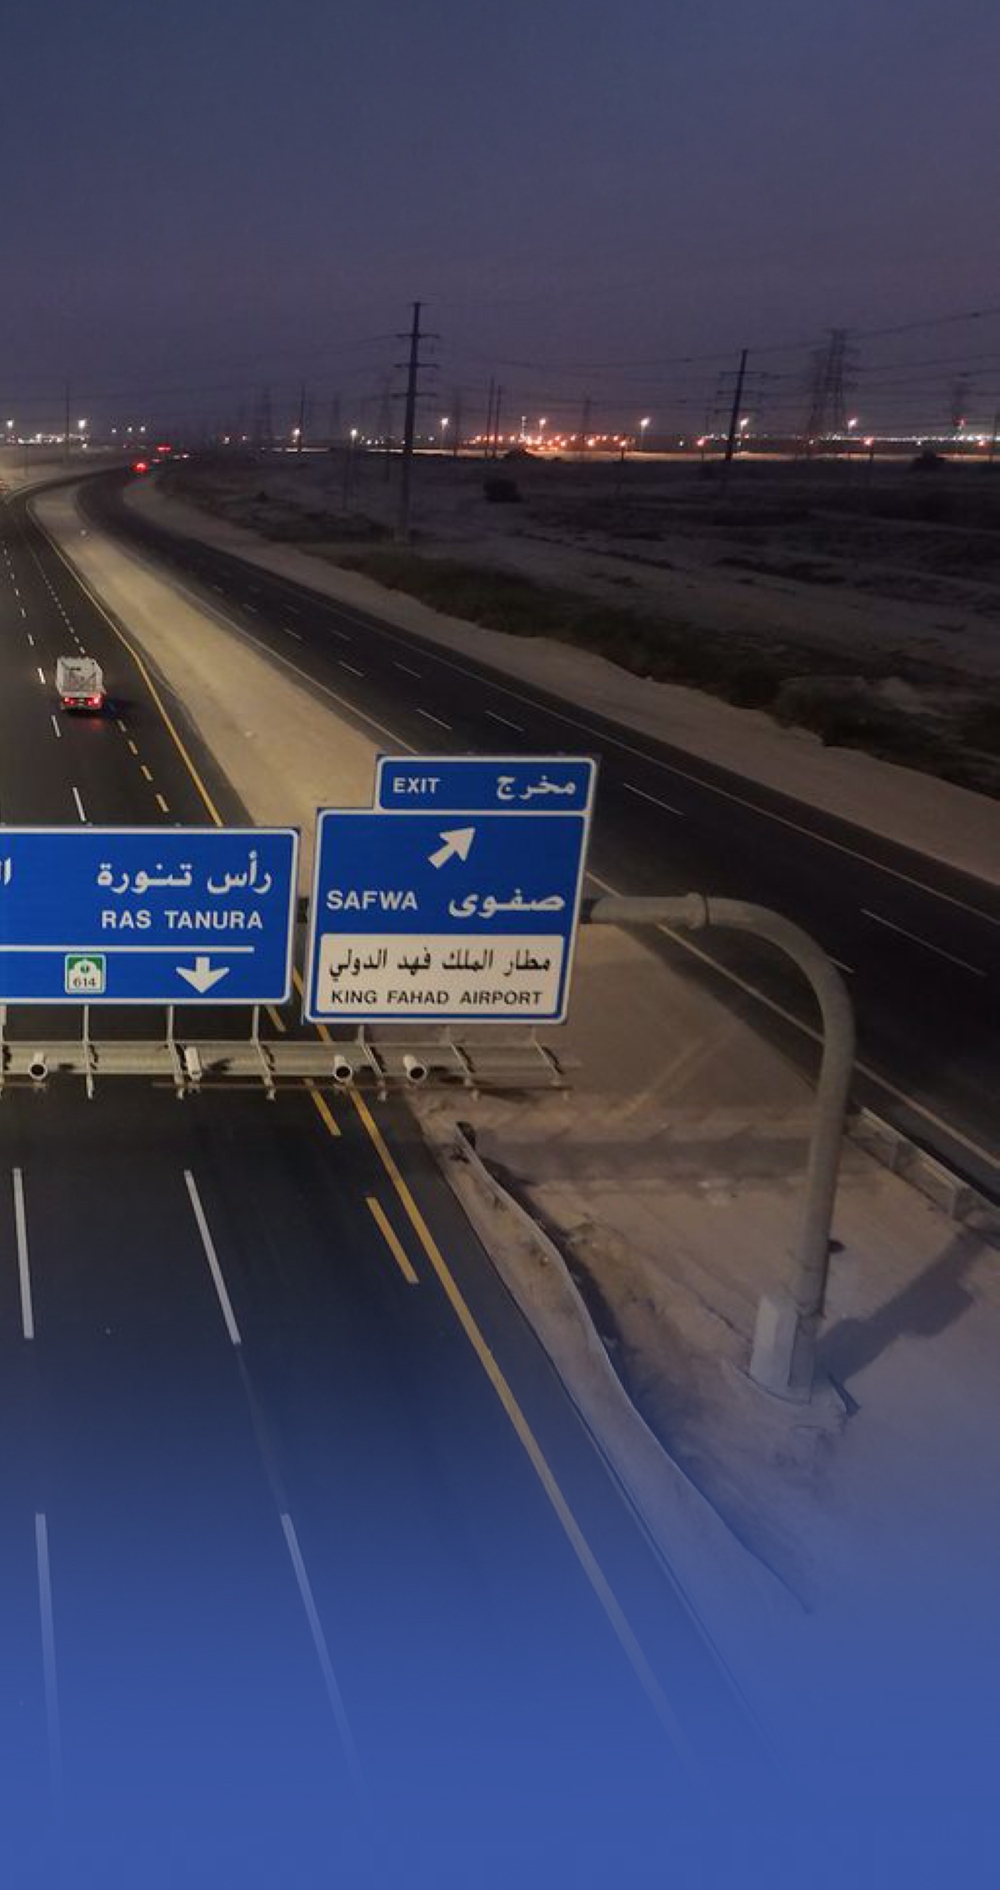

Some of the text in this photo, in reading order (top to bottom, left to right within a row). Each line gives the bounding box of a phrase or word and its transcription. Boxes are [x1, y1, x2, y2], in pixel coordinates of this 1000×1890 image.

[393, 777, 440, 794] EXIT
[496, 775, 577, 800] مخرج
[97, 850, 273, 895] رأس تنورة
[326, 889, 418, 911] SAFWA
[448, 888, 566, 919] صفوى
[101, 909, 263, 929] RAS TANURA
[329, 946, 551, 982] مطار الملك فهد الدولي
[73, 977, 96, 987] 614
[331, 989, 543, 1006] KING FAHAD AIRPORT
